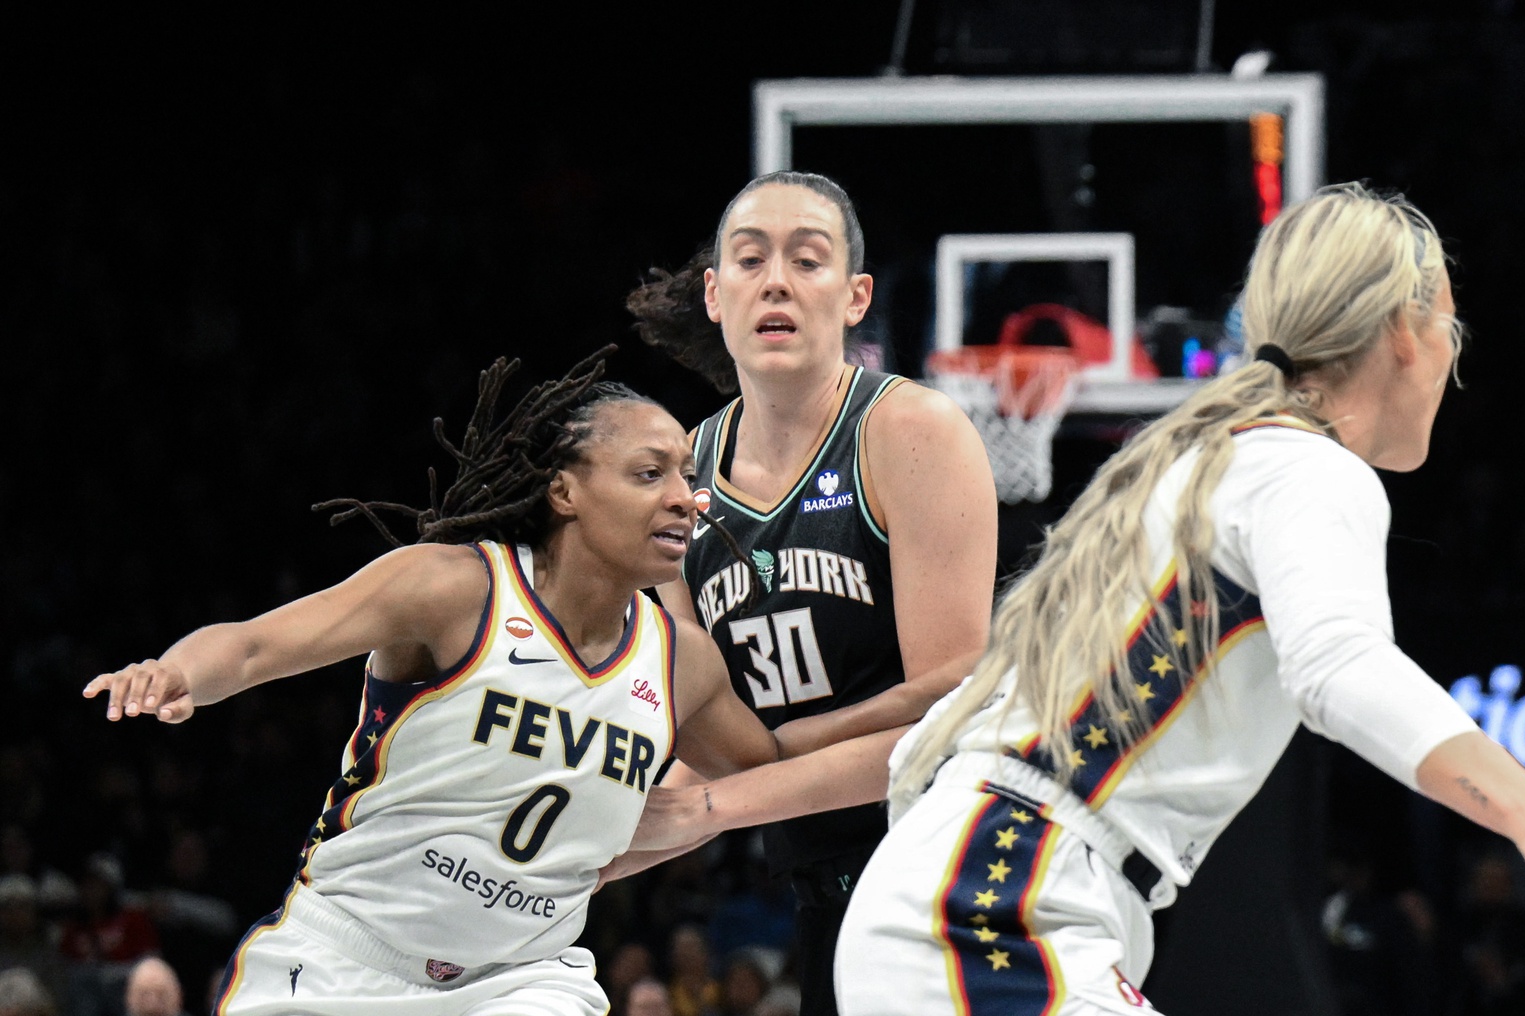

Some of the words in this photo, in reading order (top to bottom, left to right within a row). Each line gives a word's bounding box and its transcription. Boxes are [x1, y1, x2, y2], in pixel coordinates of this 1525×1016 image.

[803, 493, 853, 512] BARCLAYS
[697, 561, 752, 636] NEW
[778, 547, 874, 606] YORK
[631, 679, 661, 712] Lilly
[728, 606, 834, 709] 30
[471, 686, 656, 796] FEVER
[499, 782, 573, 866] 0
[421, 848, 556, 919] salesforce
